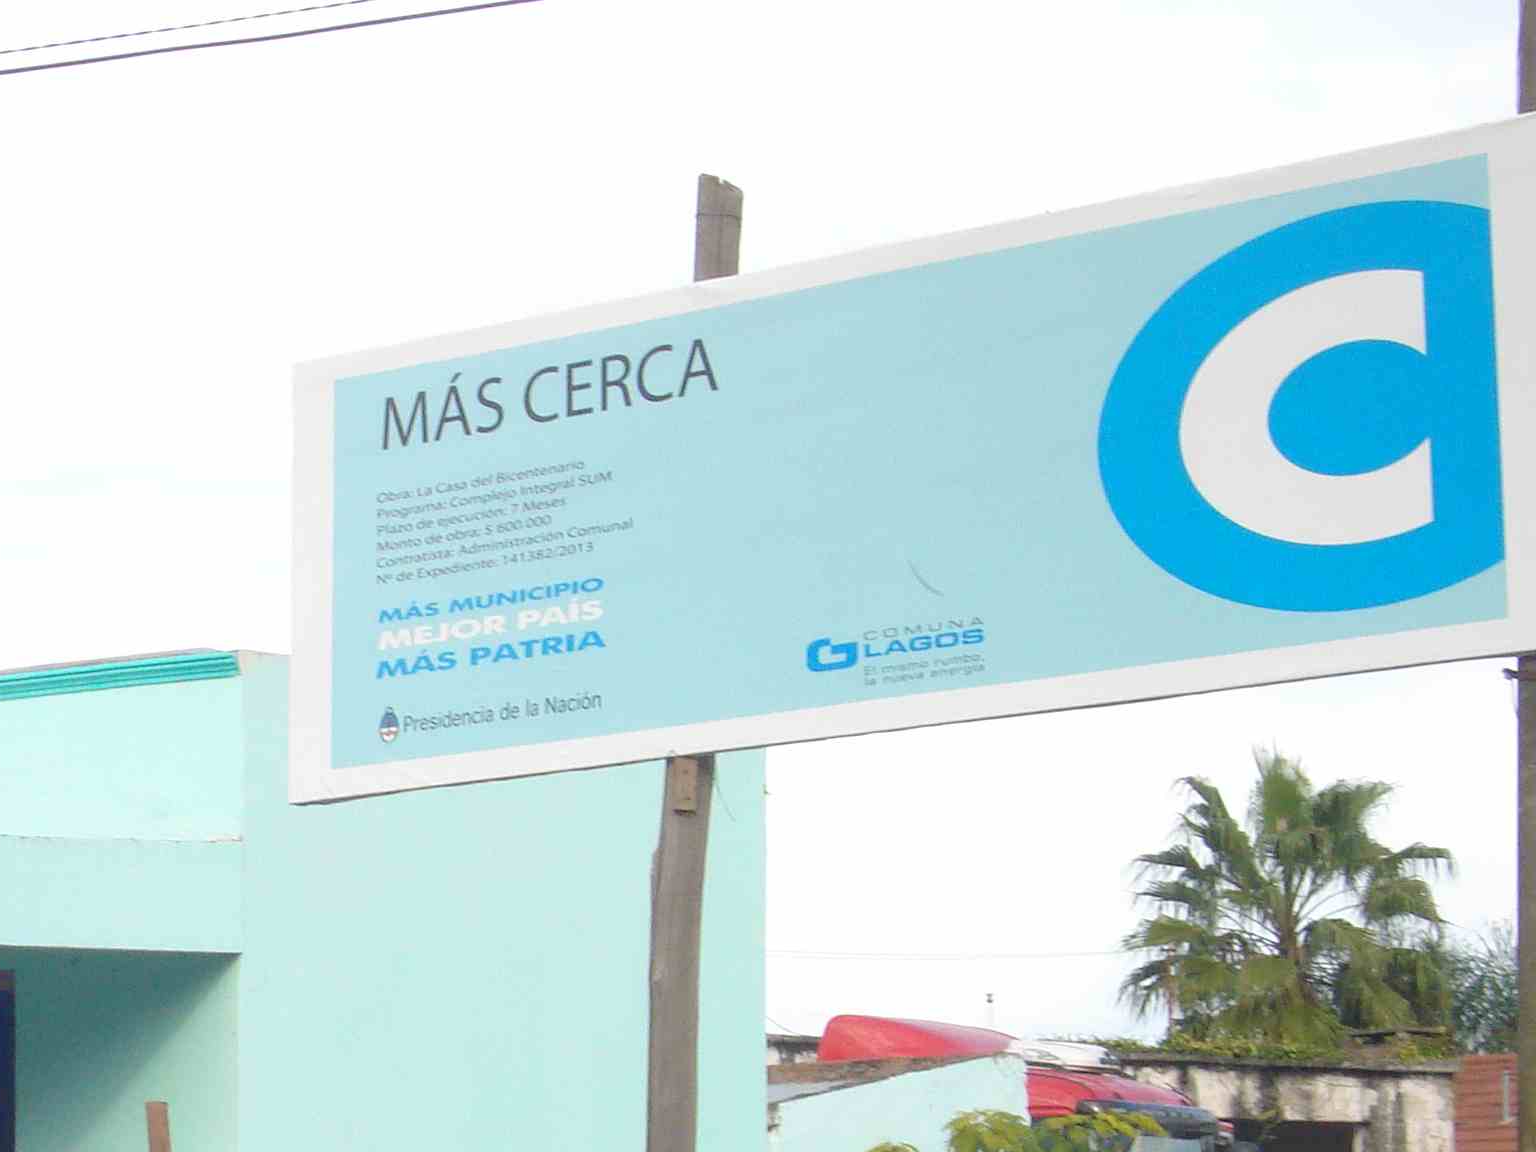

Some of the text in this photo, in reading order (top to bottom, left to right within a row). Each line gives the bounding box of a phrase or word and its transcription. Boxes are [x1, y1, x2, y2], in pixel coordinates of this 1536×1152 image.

[382, 338, 719, 450] MÁS CERCA
[376, 460, 585, 504] Obra: La Casa del Bicentenario
[376, 470, 613, 520] Programa: Complejo Integral SUM
[376, 521, 413, 535] Plazo
[416, 518, 434, 529] de
[522, 497, 566, 513] Meses
[376, 537, 421, 552] Monto
[425, 533, 443, 545] de
[445, 527, 481, 541] obra:
[376, 516, 634, 569] Contratista: Administración Comunal
[396, 571, 413, 582] de
[417, 557, 498, 580] Expediente:
[378, 577, 604, 624] MÁS MUNICIPIO
[378, 597, 604, 651] MEJOR PAÍS
[864, 616, 984, 641] COMUNA
[864, 628, 985, 658] LAGOS
[376, 630, 606, 680] MÁS PATRIA
[403, 691, 603, 733] Presidencia de la Nación
